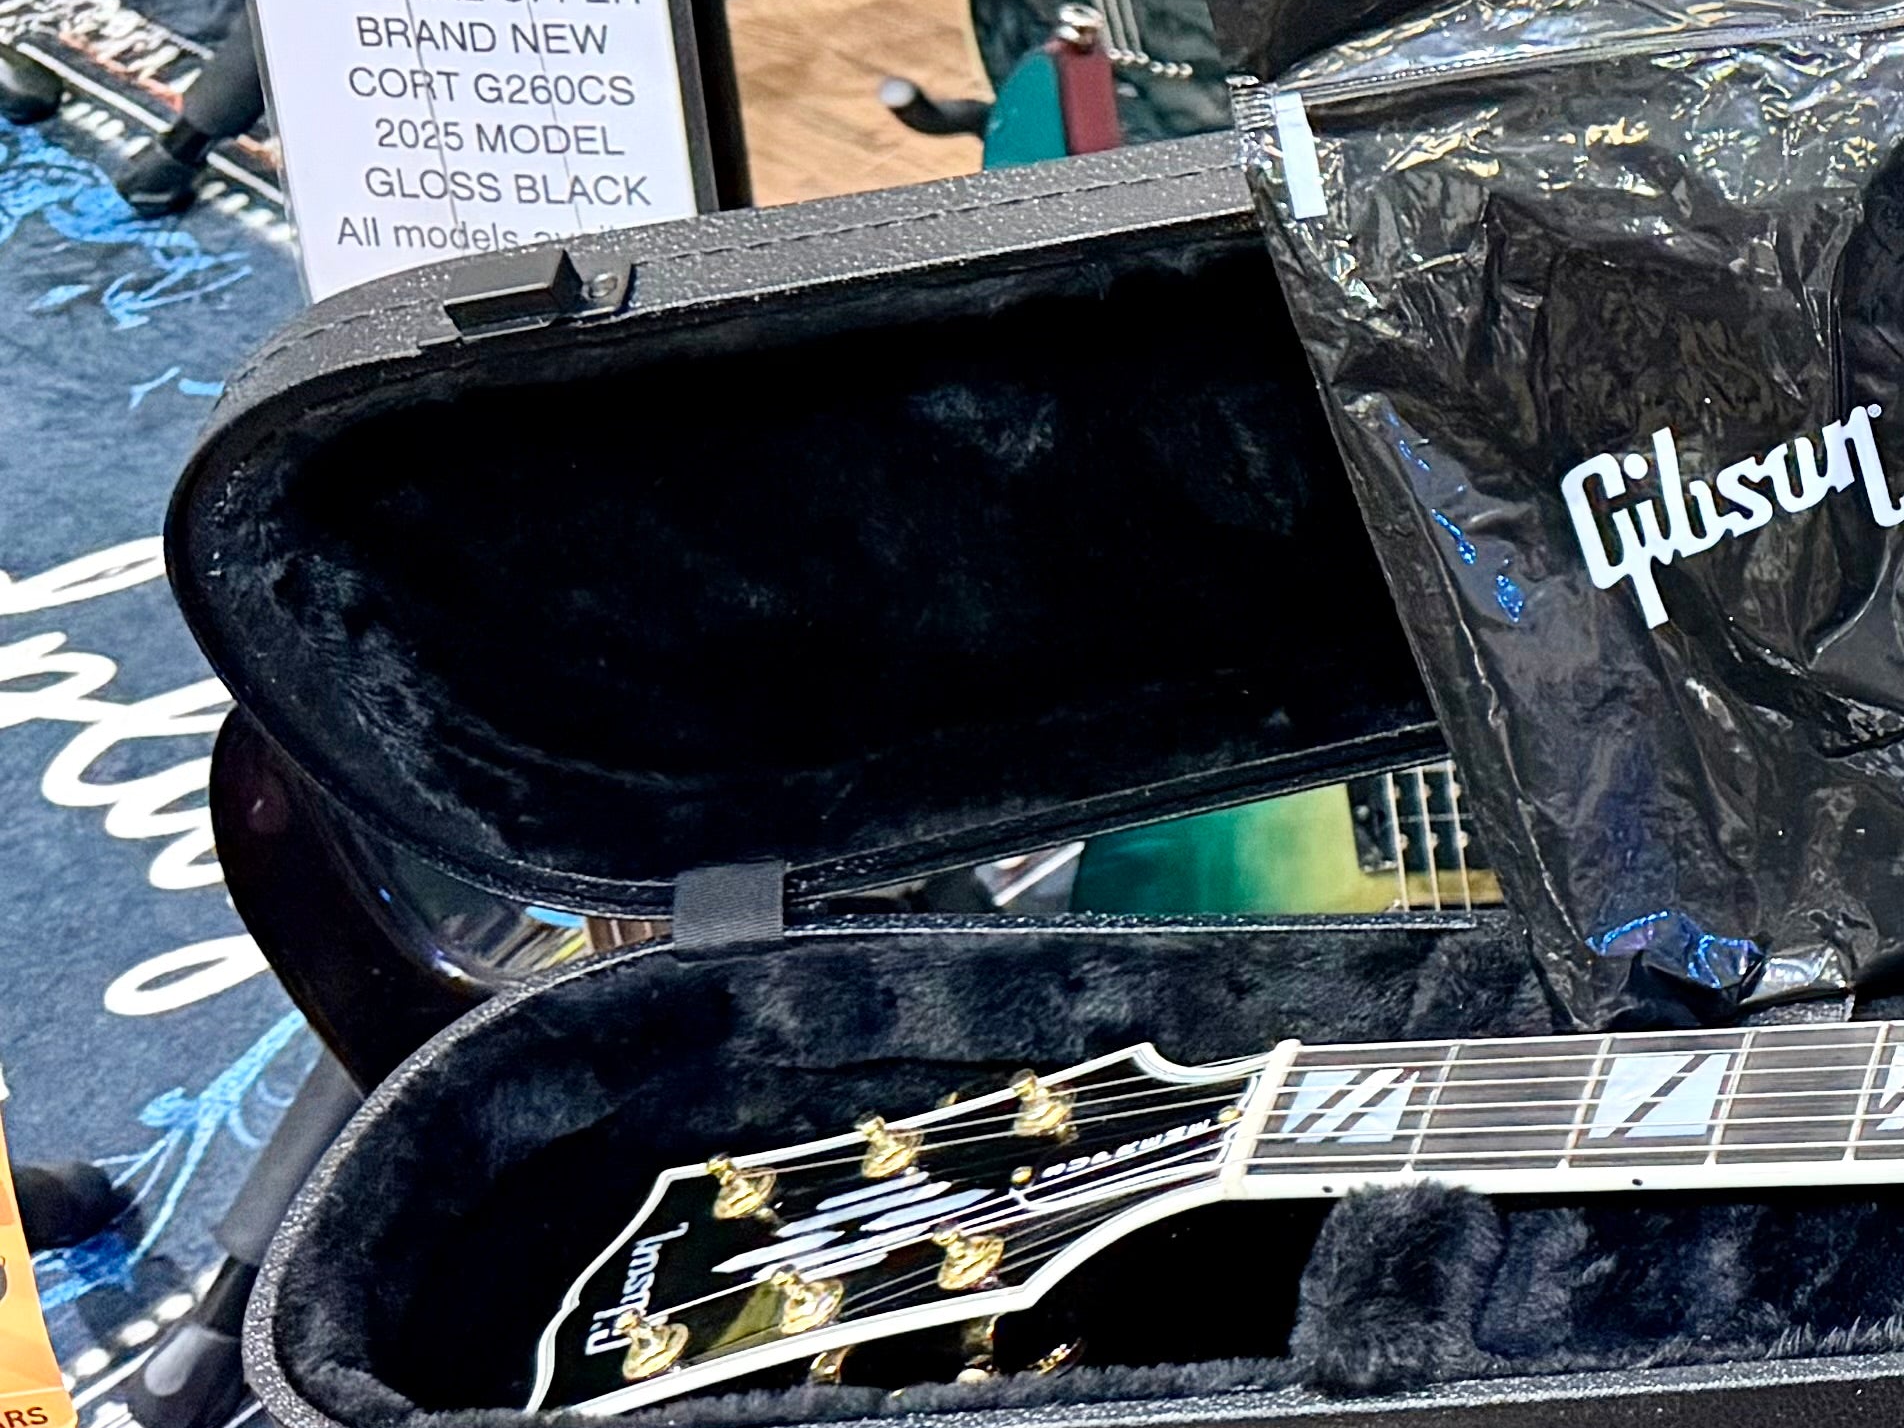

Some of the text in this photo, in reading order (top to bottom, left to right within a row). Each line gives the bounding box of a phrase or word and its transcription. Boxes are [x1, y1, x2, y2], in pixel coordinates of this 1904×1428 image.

[356, 16, 608, 55] BRAND NEW
[348, 67, 635, 107] CORT G260CS
[375, 119, 625, 156] 2025 MODEL
[364, 168, 652, 206] GLOSS BLACK
[337, 216, 381, 248] All
[393, 220, 518, 251] models
